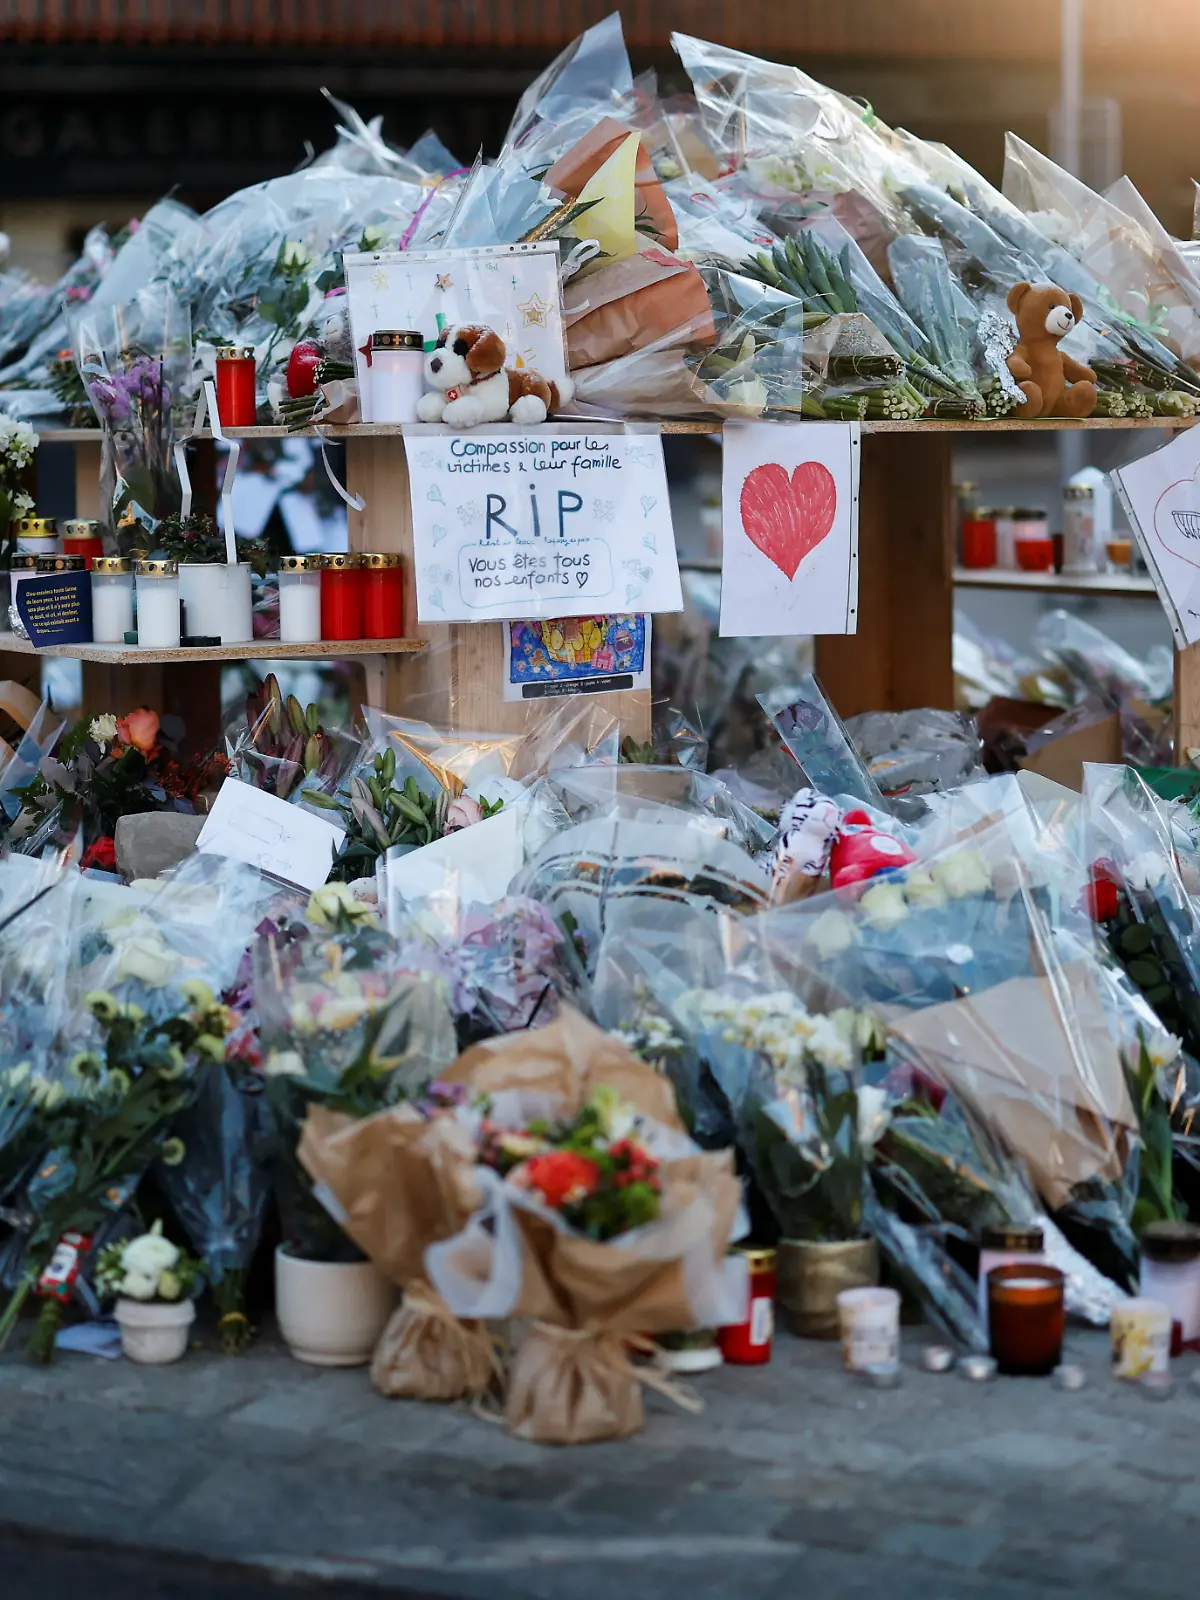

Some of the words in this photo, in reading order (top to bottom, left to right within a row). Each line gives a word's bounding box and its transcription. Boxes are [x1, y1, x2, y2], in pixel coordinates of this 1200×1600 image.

[451, 437, 545, 464] Compassion
[551, 439, 581, 459] pour
[447, 458, 510, 473] victimes
[533, 458, 567, 470] leur
[571, 454, 622, 477] famille
[513, 553, 546, 570] êtes
[553, 552, 590, 569] tous
[475, 575, 501, 588] nos
